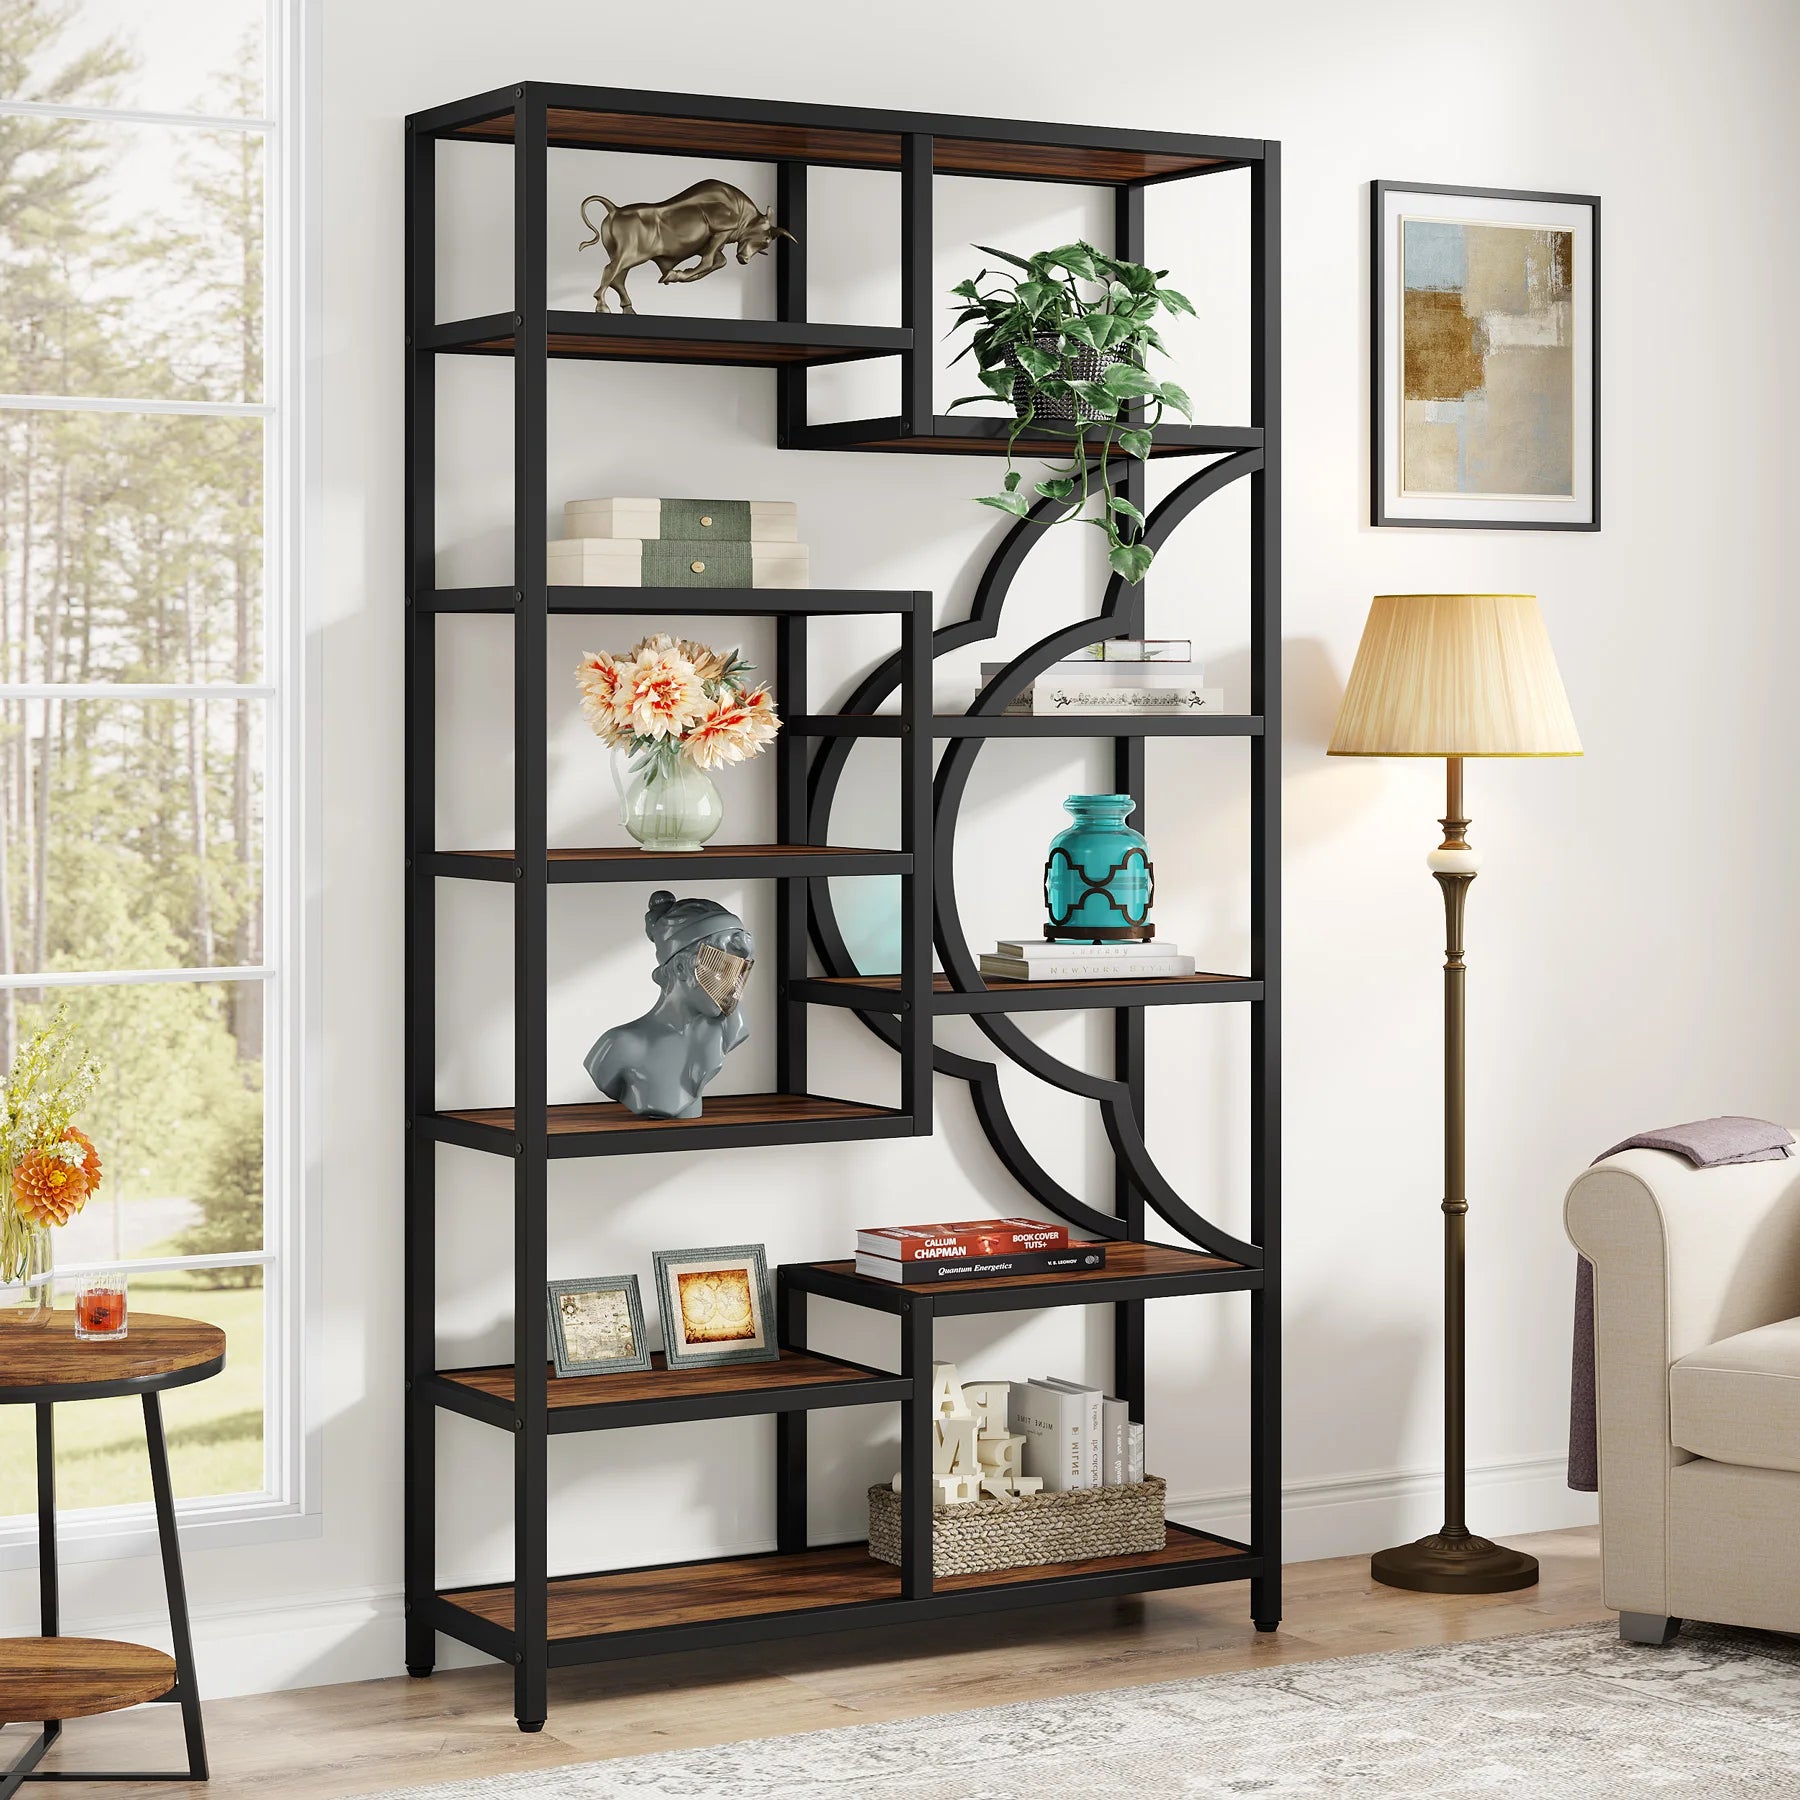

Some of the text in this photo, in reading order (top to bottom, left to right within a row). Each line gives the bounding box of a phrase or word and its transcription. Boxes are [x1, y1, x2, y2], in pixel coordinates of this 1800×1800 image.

[925, 1238, 957, 1248] CALLUM
[1012, 1231, 1059, 1243] BOOK COVER
[1024, 1241, 1047, 1249] TUTS+
[914, 1246, 967, 1259] CHAPMAN
[938, 1262, 1013, 1276] Quantum Energetics
